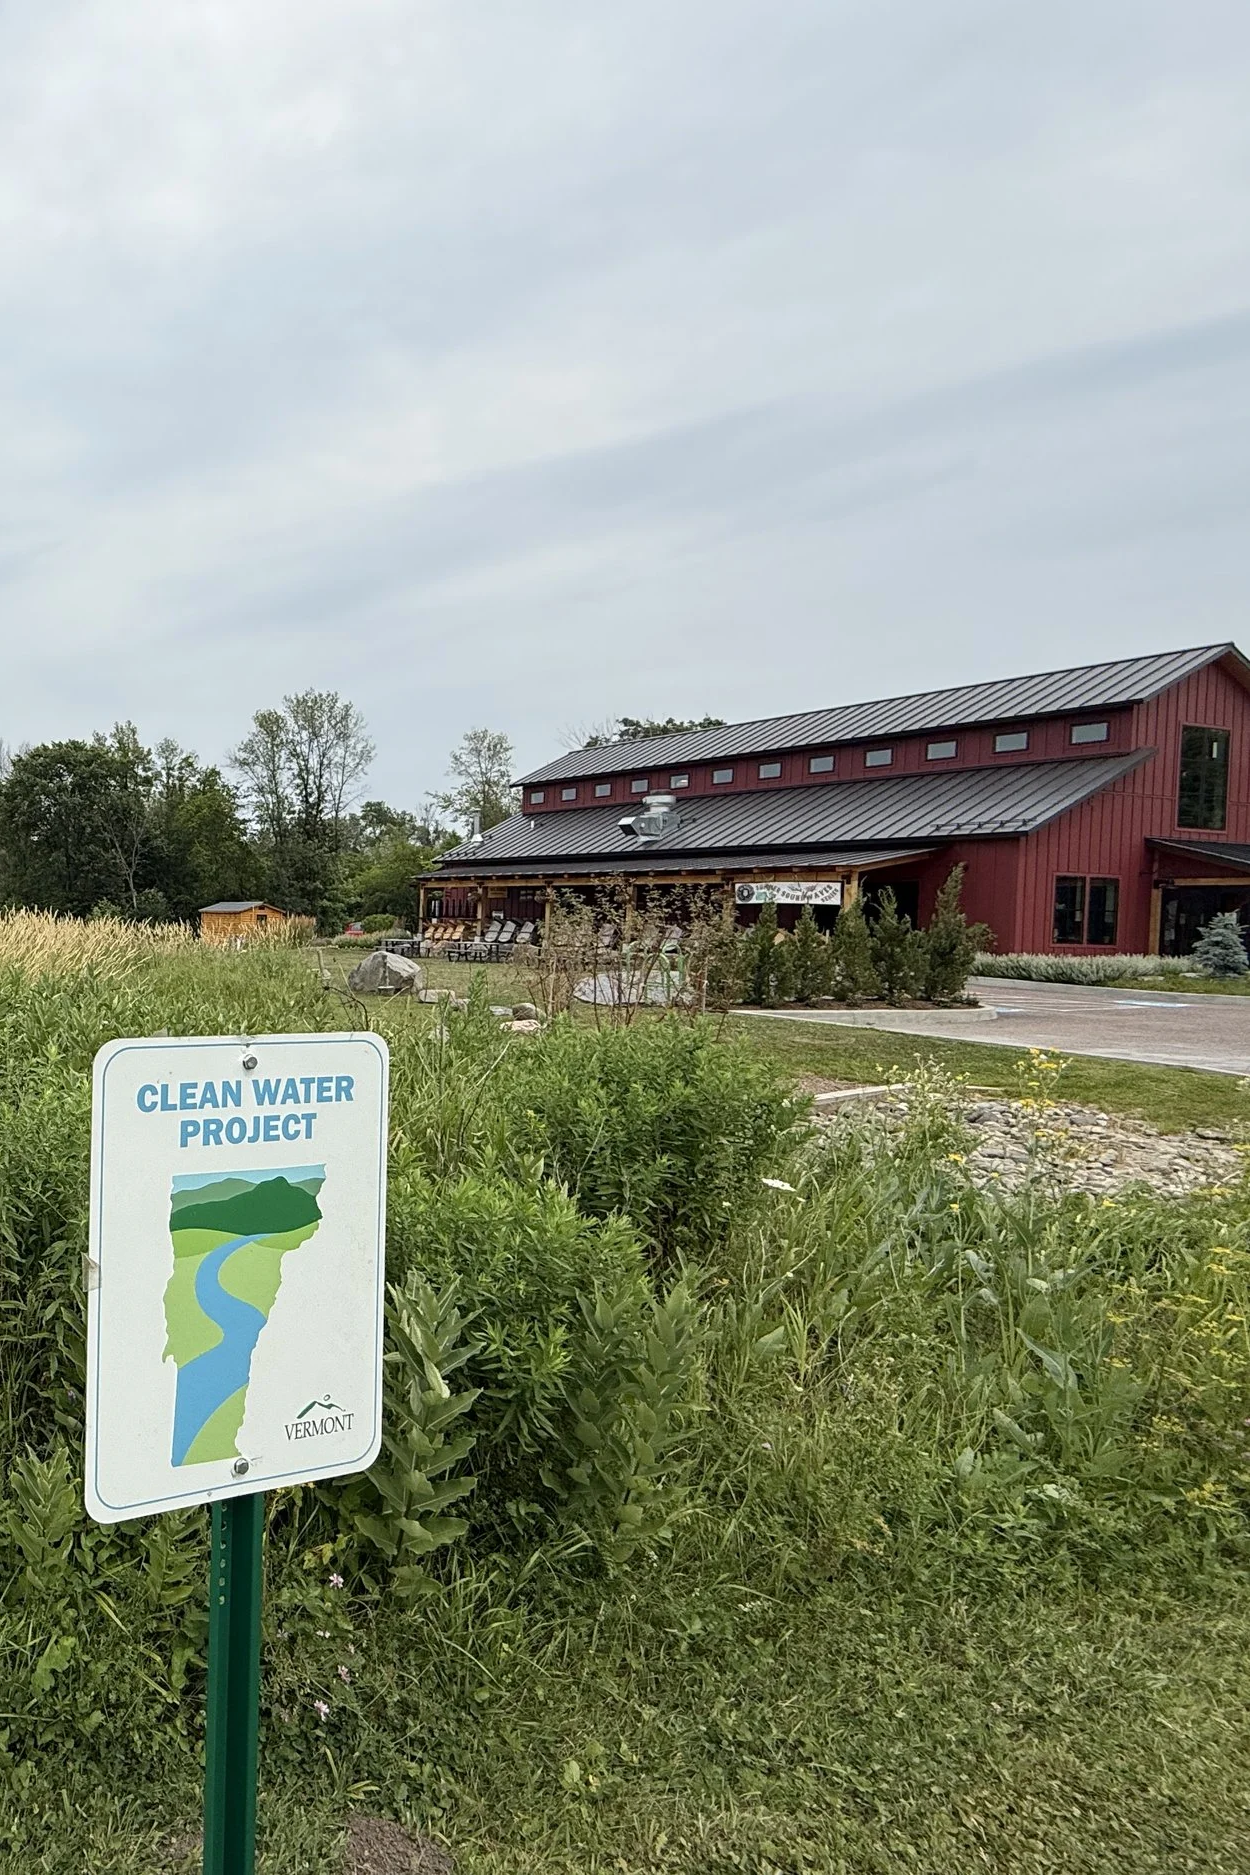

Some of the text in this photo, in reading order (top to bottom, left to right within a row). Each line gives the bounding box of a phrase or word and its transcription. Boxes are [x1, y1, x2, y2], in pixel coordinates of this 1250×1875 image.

[137, 1076, 354, 1112] CLEAN WATER
[180, 1113, 317, 1147] PROJECT
[285, 1413, 354, 1440] VERMONT
